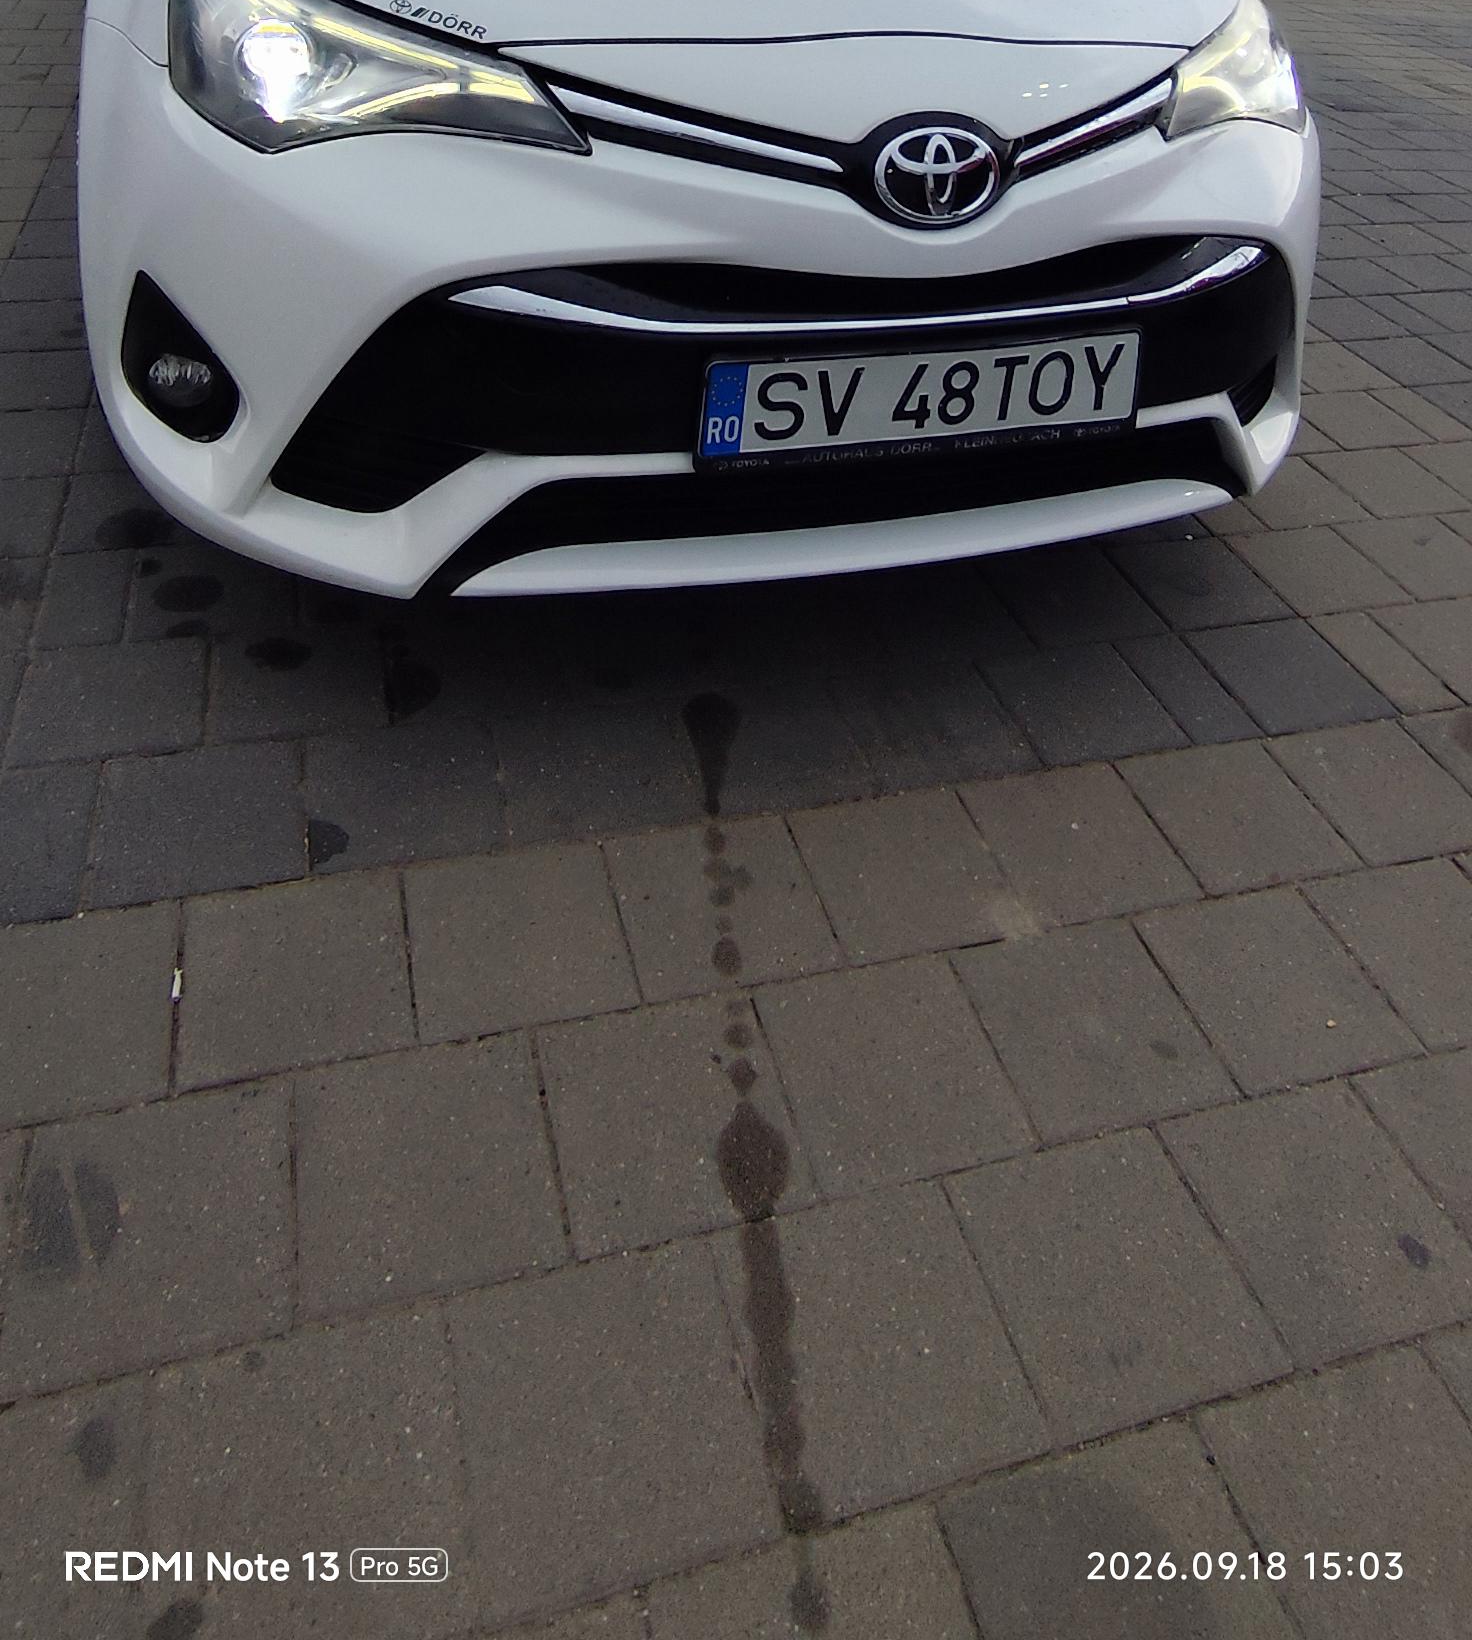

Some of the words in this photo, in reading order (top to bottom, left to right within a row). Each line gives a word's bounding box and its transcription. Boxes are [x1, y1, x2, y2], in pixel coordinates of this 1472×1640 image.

[428, 11, 487, 39] DÖRR
[754, 367, 865, 440] SV
[706, 416, 740, 444] RO
